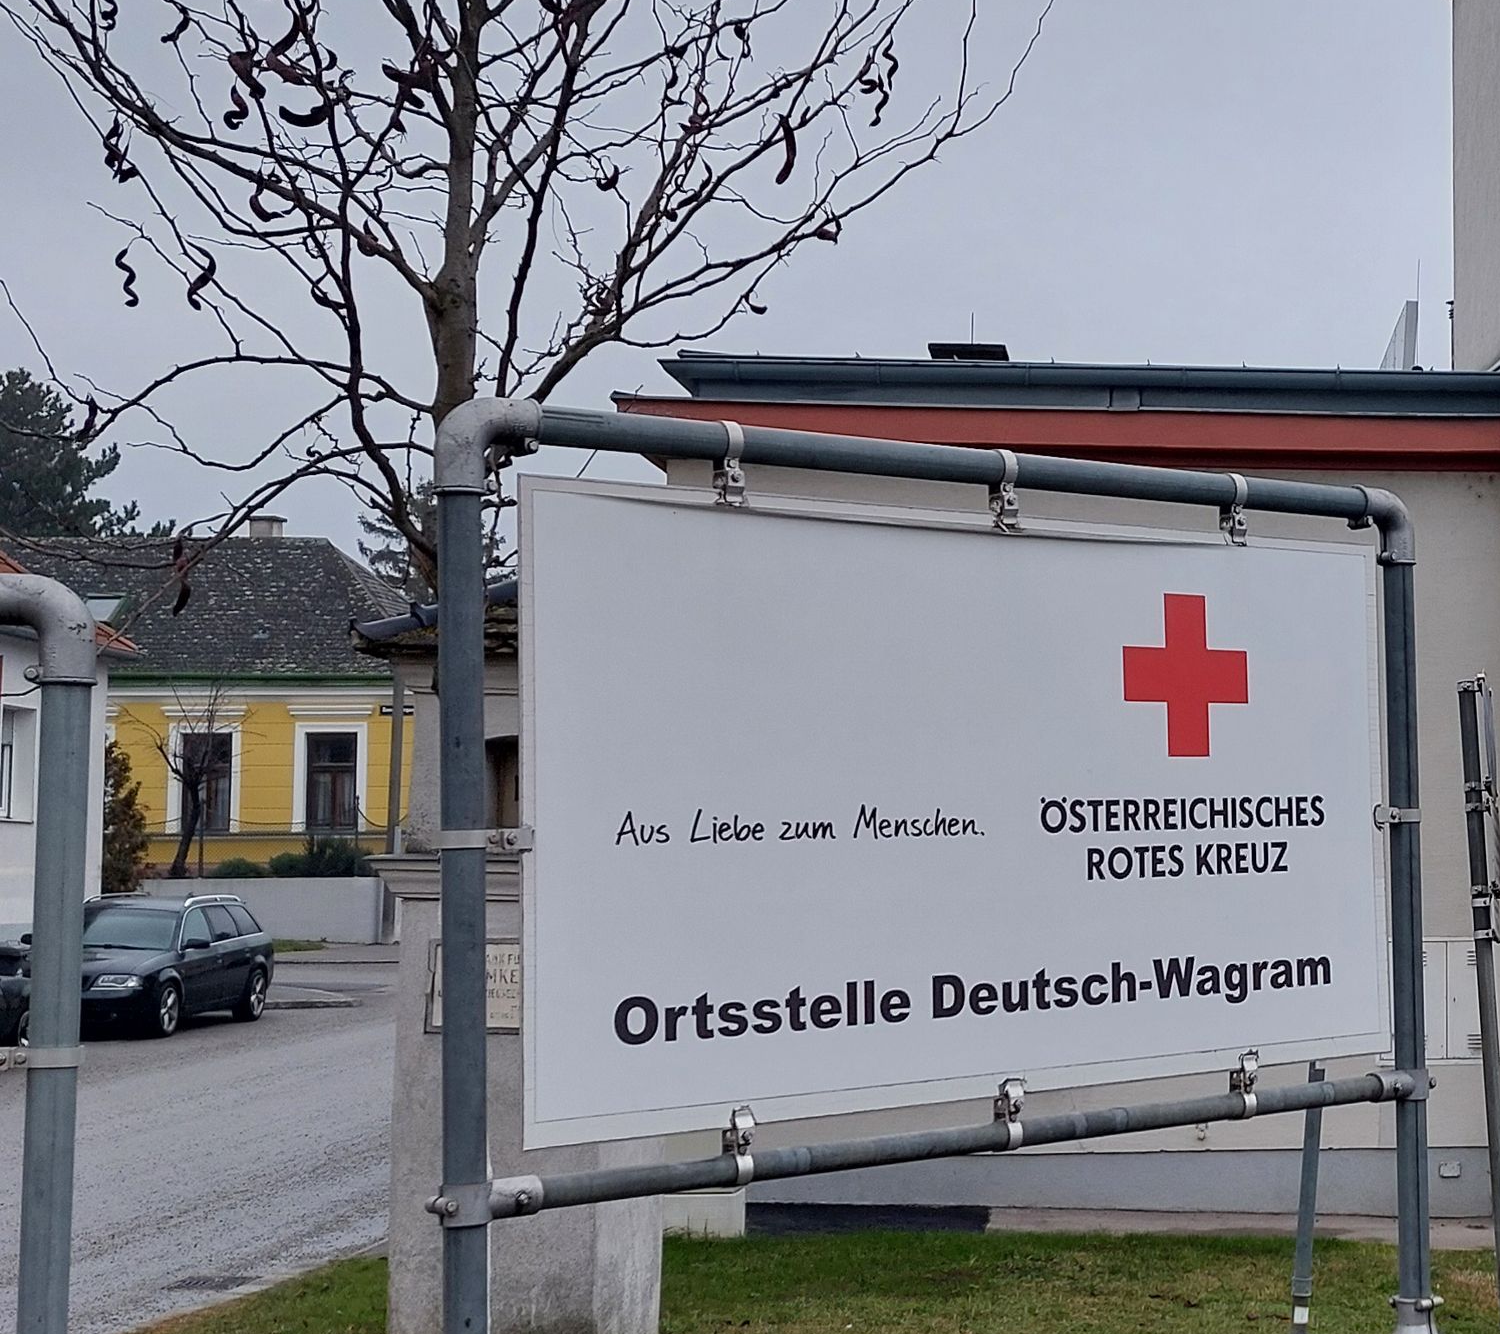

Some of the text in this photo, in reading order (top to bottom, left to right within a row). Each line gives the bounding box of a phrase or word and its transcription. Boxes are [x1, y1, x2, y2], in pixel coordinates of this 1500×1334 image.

[615, 804, 986, 846] Aus Liebe zum Menschen.
[1040, 795, 1326, 834] ÖSTERREICHISCHES
[1087, 841, 1289, 880] ROTES KREUZ
[613, 955, 1332, 1046] Ortsstelle Deutsch-Wagram
